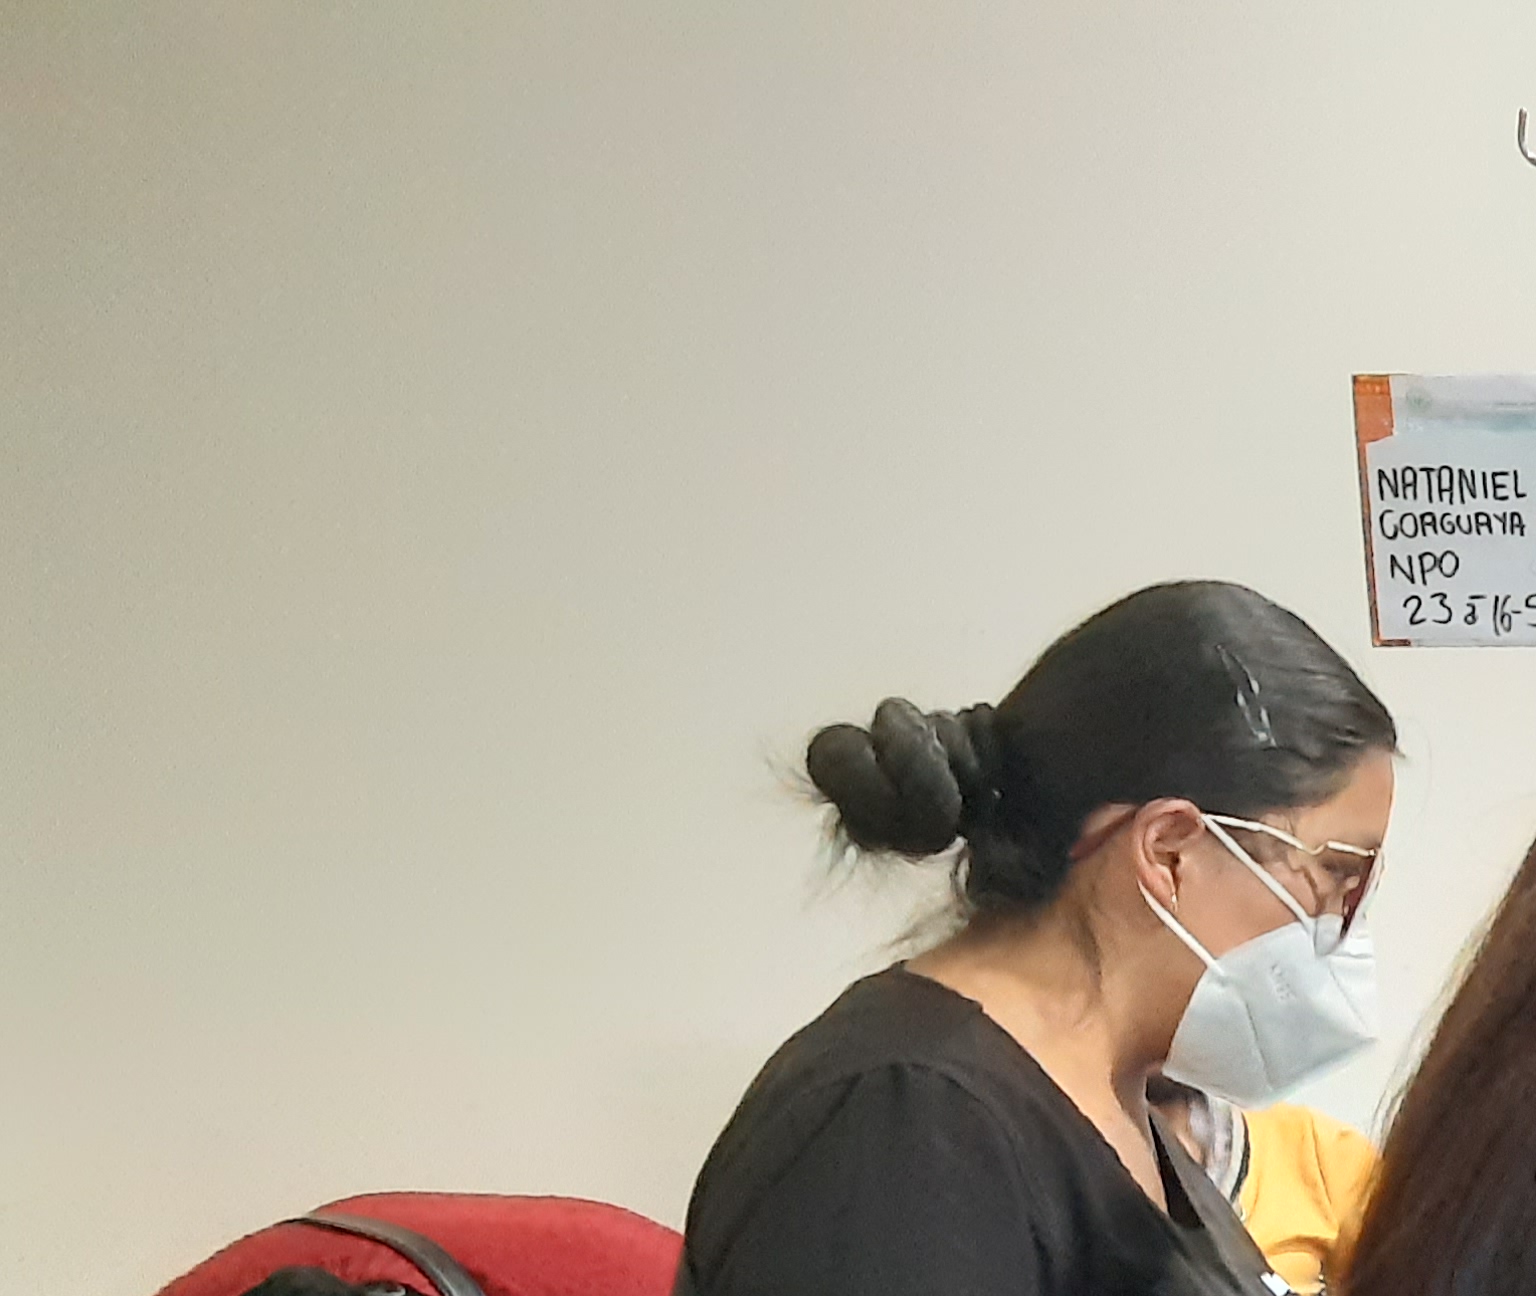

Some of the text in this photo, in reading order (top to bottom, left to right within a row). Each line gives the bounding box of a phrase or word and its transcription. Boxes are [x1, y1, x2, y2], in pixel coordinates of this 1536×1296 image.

[1377, 464, 1528, 506] NATANIEL
[1389, 550, 1460, 586] NPO
[1402, 592, 1453, 626] 23
